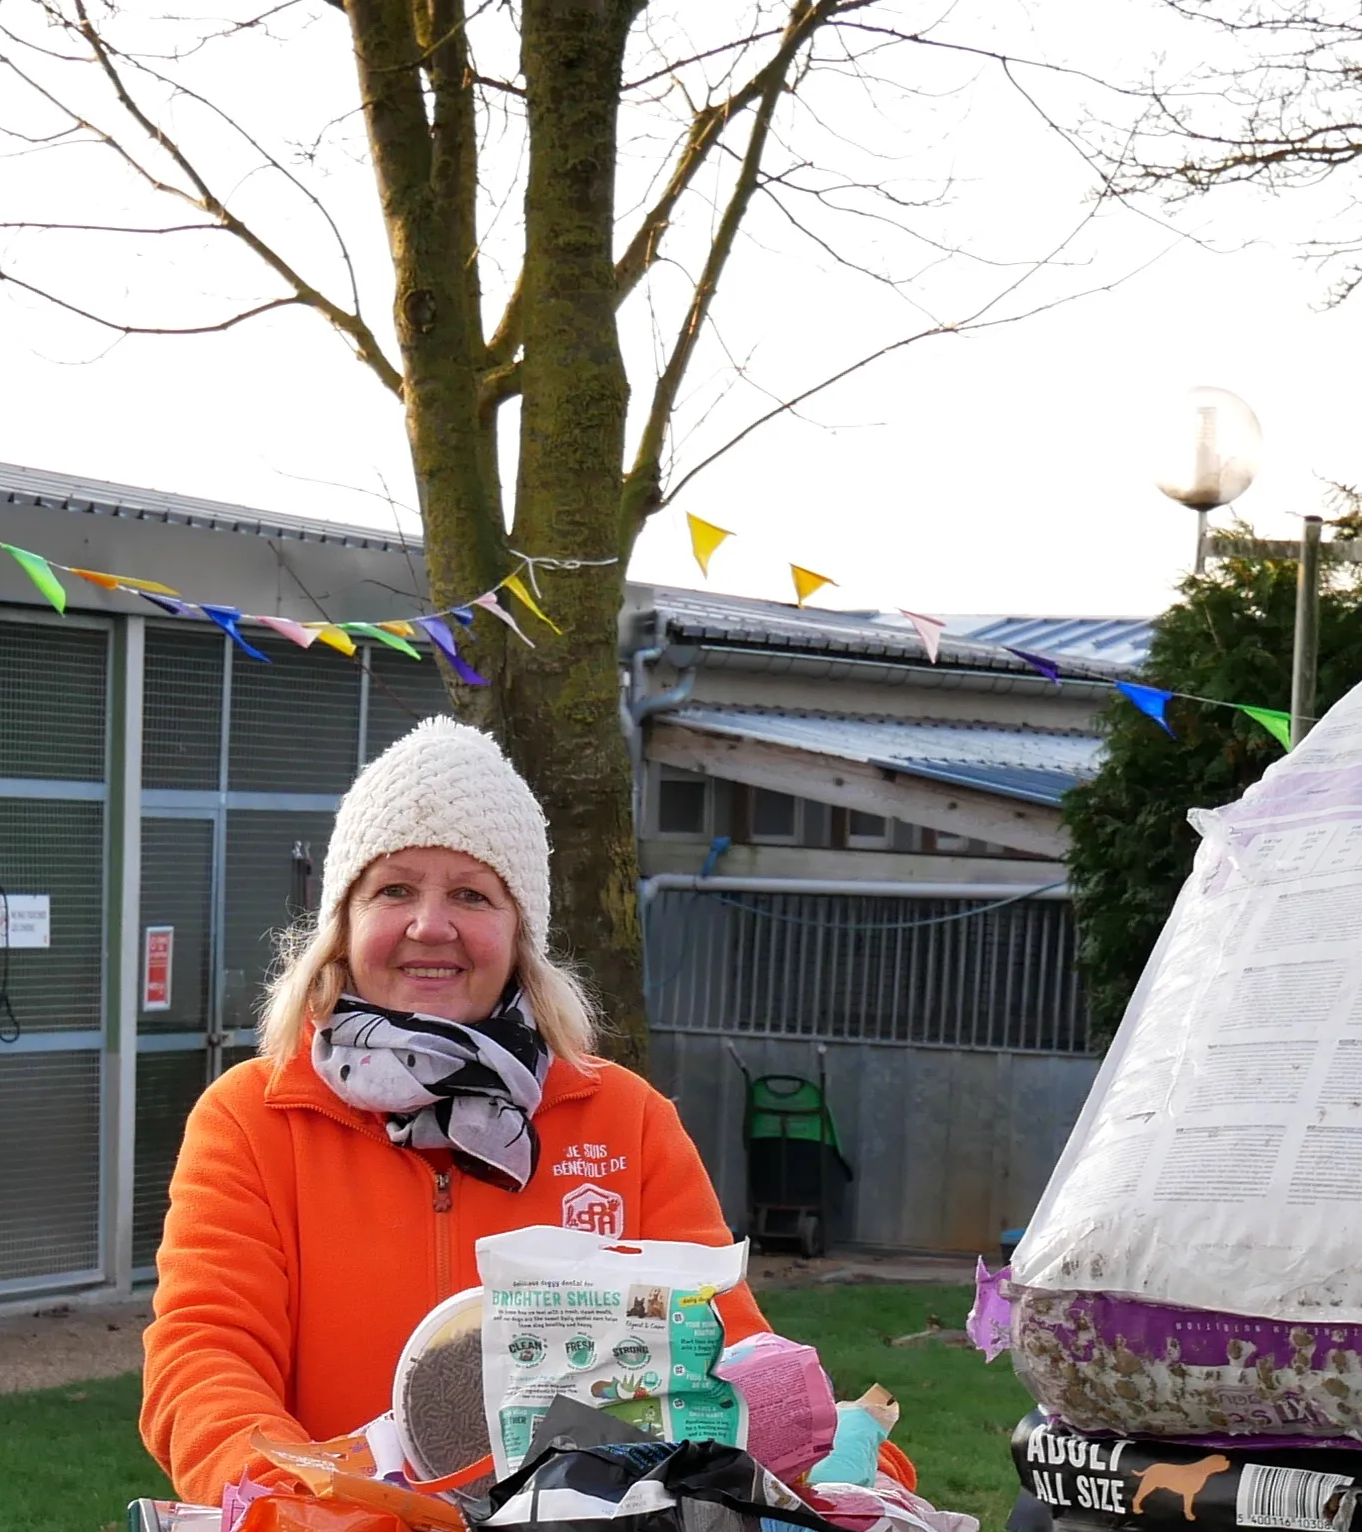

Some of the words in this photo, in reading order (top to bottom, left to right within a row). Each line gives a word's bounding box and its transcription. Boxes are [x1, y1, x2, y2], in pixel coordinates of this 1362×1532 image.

[566, 1145, 581, 1158] JE
[583, 1143, 607, 1159] SUIS
[553, 1158, 607, 1178] BÉNÉVOLE
[610, 1156, 627, 1172] DE
[577, 1202, 616, 1235] SPA
[492, 1290, 561, 1307] BRIGHTER
[567, 1290, 621, 1307] SMILES
[508, 1340, 542, 1353] CLEAN
[565, 1340, 595, 1354] FRESH
[612, 1345, 649, 1357] STRONG
[1027, 1423, 1135, 1472] ADULT
[1031, 1469, 1071, 1506] ALL
[1076, 1474, 1127, 1515] SIZE
